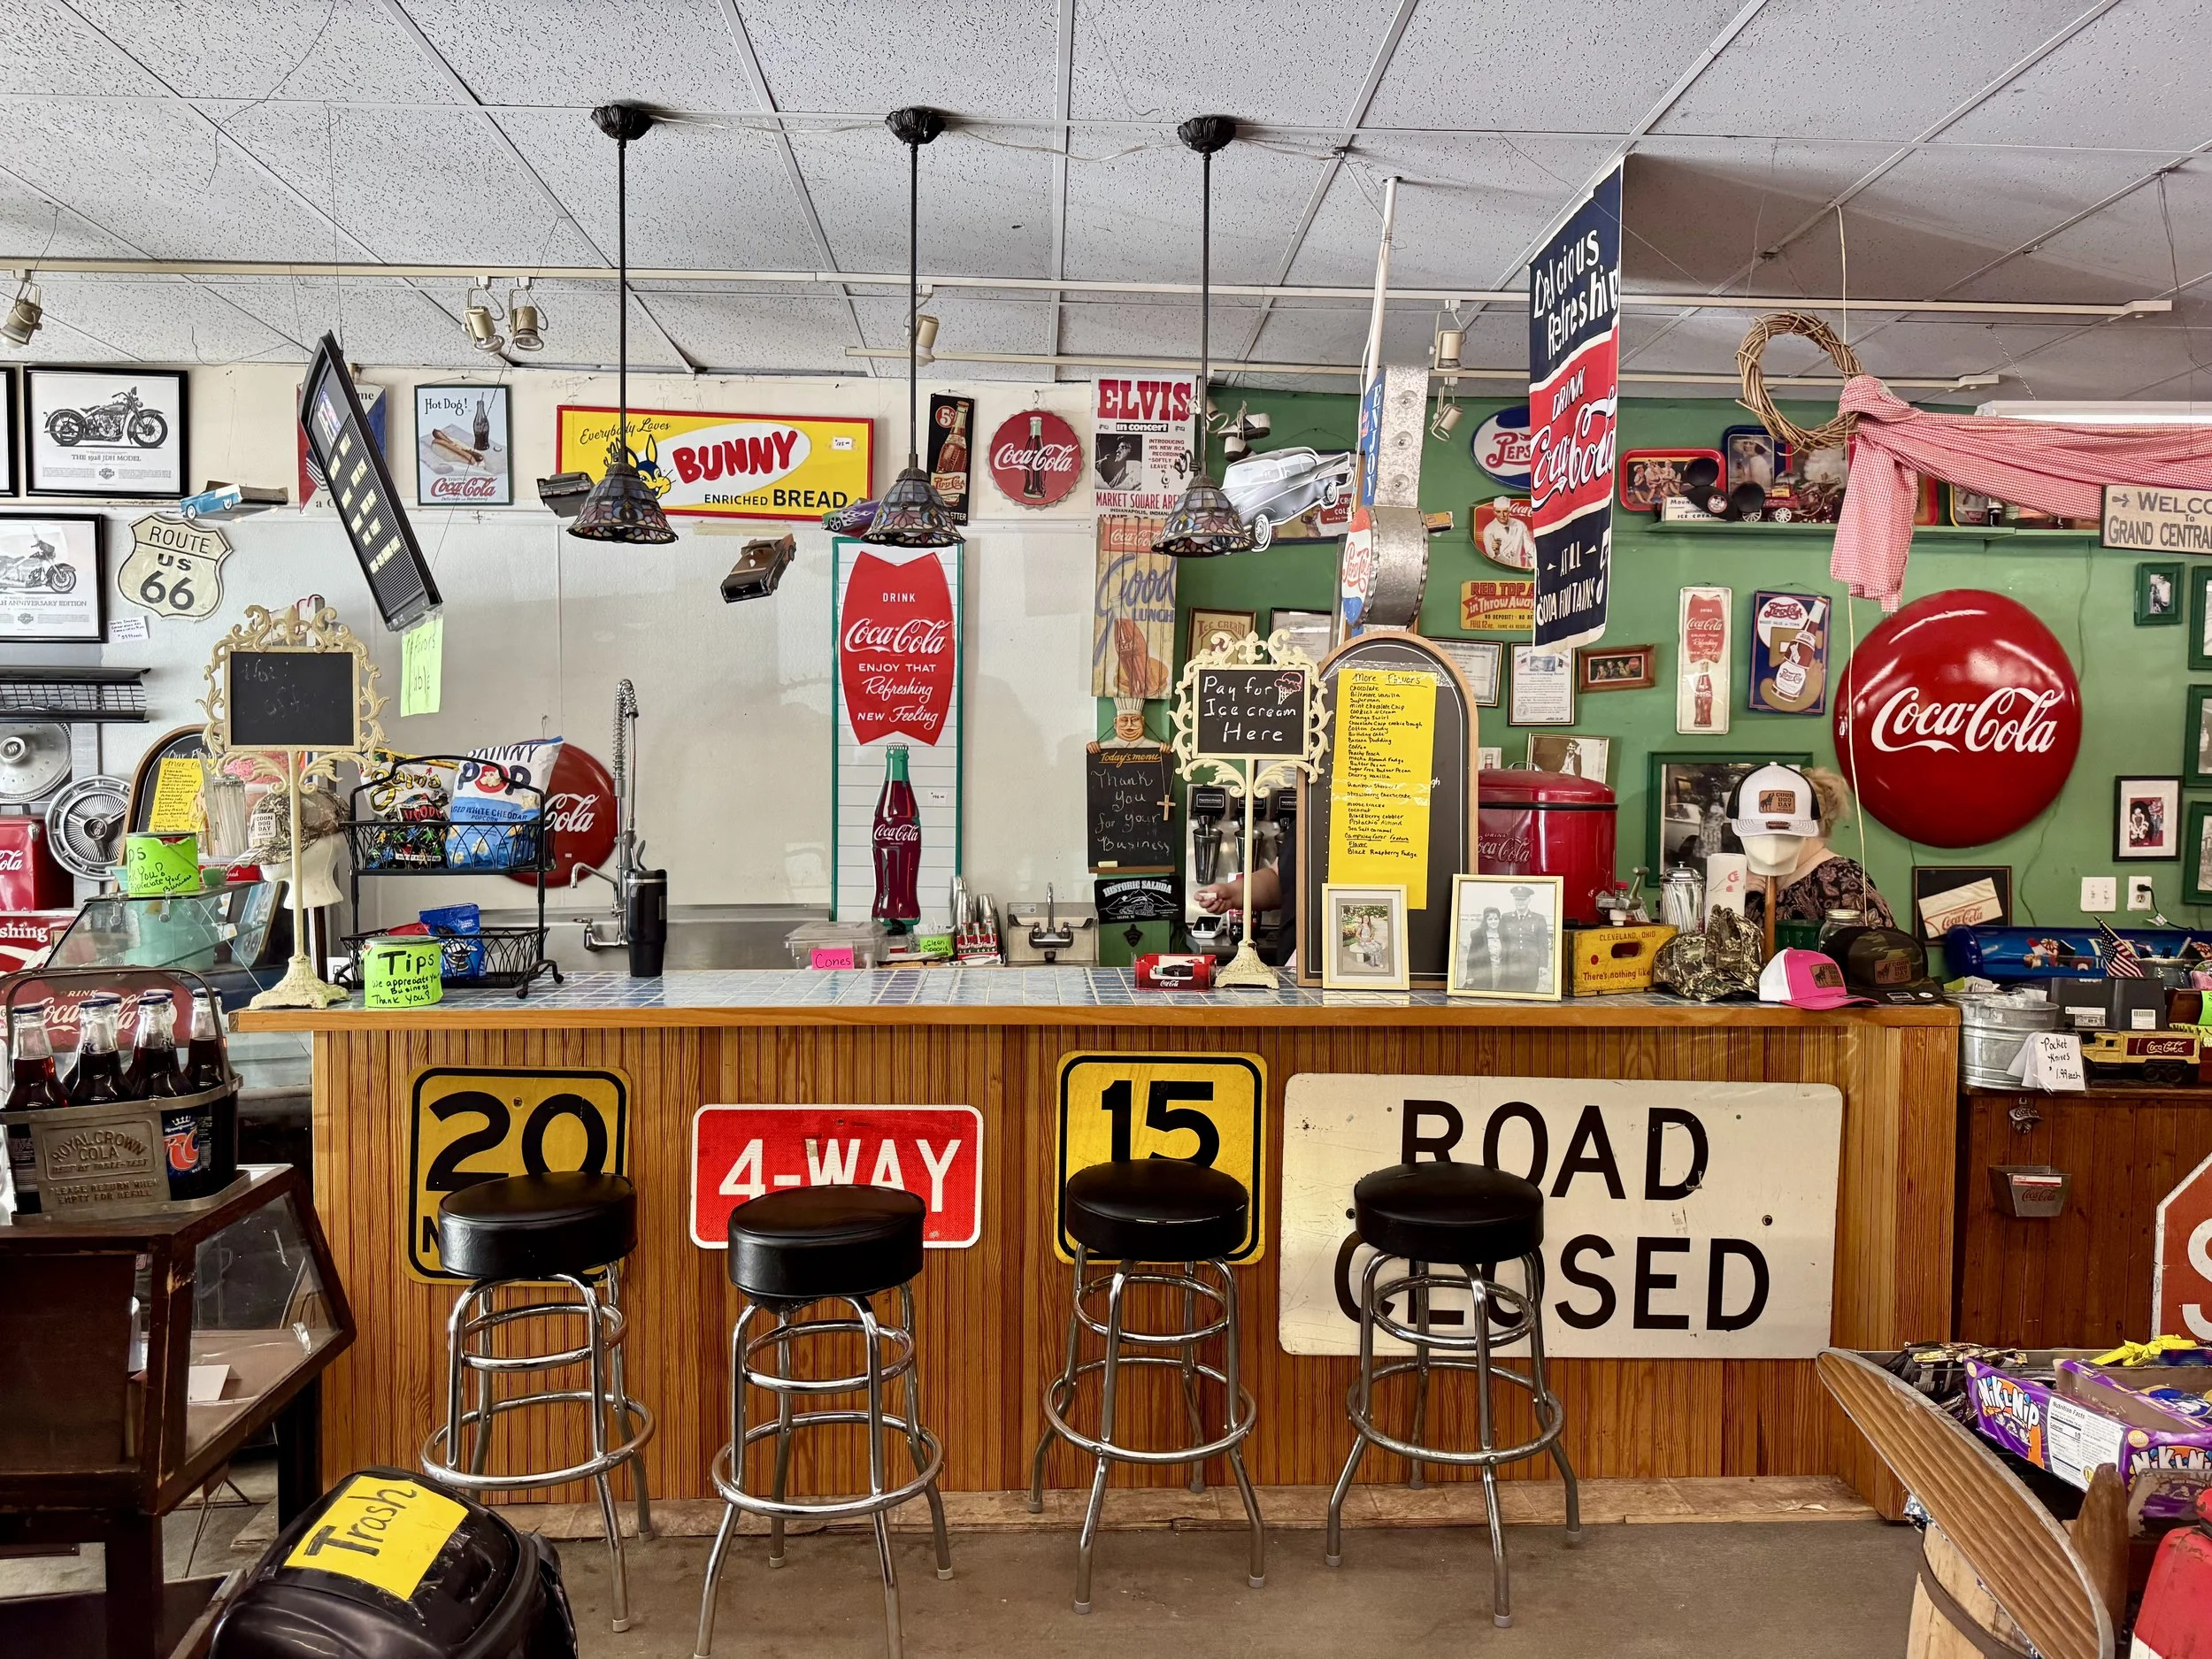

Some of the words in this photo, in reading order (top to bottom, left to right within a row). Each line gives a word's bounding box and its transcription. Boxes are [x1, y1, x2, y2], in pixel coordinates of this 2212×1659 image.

[1098, 379, 1192, 421] ELVIS
[1552, 365, 1586, 420] DRINK
[425, 398, 442, 414] Hot
[637, 419, 671, 433] Loves
[672, 430, 798, 484] BUNNY
[994, 442, 1078, 472] Coca-Cola
[704, 494, 768, 506] ENRICHED
[773, 489, 848, 509] BREAD
[1096, 492, 1127, 508] MARKET
[1131, 494, 1160, 509] SQUARE
[149, 526, 211, 554] ROUTE
[2108, 515, 2154, 545] GRAND
[2160, 522, 2212, 549] CENTRA
[157, 553, 192, 571] US
[140, 571, 195, 611] 66
[883, 593, 916, 603] DRINK
[1471, 582, 1496, 595] RED
[1500, 582, 1525, 595] TOP
[1132, 608, 1173, 623] LUNCH
[845, 618, 953, 655] Coca-Cola
[858, 664, 900, 672] ENJOY
[905, 664, 936, 672] THAT
[1352, 673, 1377, 682] More
[862, 676, 933, 703] Refreshing
[1203, 675, 1236, 701] Pay
[1245, 677, 1272, 695] for
[857, 712, 885, 721] NEW
[889, 706, 939, 730] Feeling
[1204, 698, 1238, 717] Ice
[1247, 706, 1296, 718] cream
[1871, 686, 2065, 753] Coca-Cola
[1223, 722, 1283, 742] Here
[1091, 770, 1153, 790] Thank
[466, 807, 490, 816] WHITE
[492, 810, 528, 820] CHEDDAR
[1095, 812, 1116, 834] for
[874, 824, 920, 841] Coca-Cola
[1098, 836, 1170, 855] Business
[1478, 836, 1531, 864] oca-Cola
[1102, 879, 1141, 897] HISTORIC
[1141, 880, 1172, 894] SALUDA
[378, 950, 434, 976] Tips
[815, 956, 851, 968] Cones
[1583, 971, 1608, 980] There's
[1609, 970, 1637, 980] nothing
[372, 995, 400, 1005] Thank
[2040, 1037, 2068, 1052] Pocket
[2047, 1052, 2070, 1064] Knives
[1101, 1080, 1221, 1167] 15
[94, 1130, 148, 1156] CROWN
[426, 1091, 608, 1192] 20
[1402, 1099, 1709, 1202] ROAD
[79, 1144, 120, 1161] COLA
[719, 1139, 962, 1213] 4-WAY
[58, 1194, 90, 1204] EMPTY
[94, 1192, 113, 1202] FOR
[117, 1189, 152, 1199] REFILL
[90, 1181, 130, 1192] RETURN
[2053, 1401, 2073, 1415] Nutrition
[2073, 1409, 2085, 1419] Facts
[303, 1488, 417, 1557] Trash
